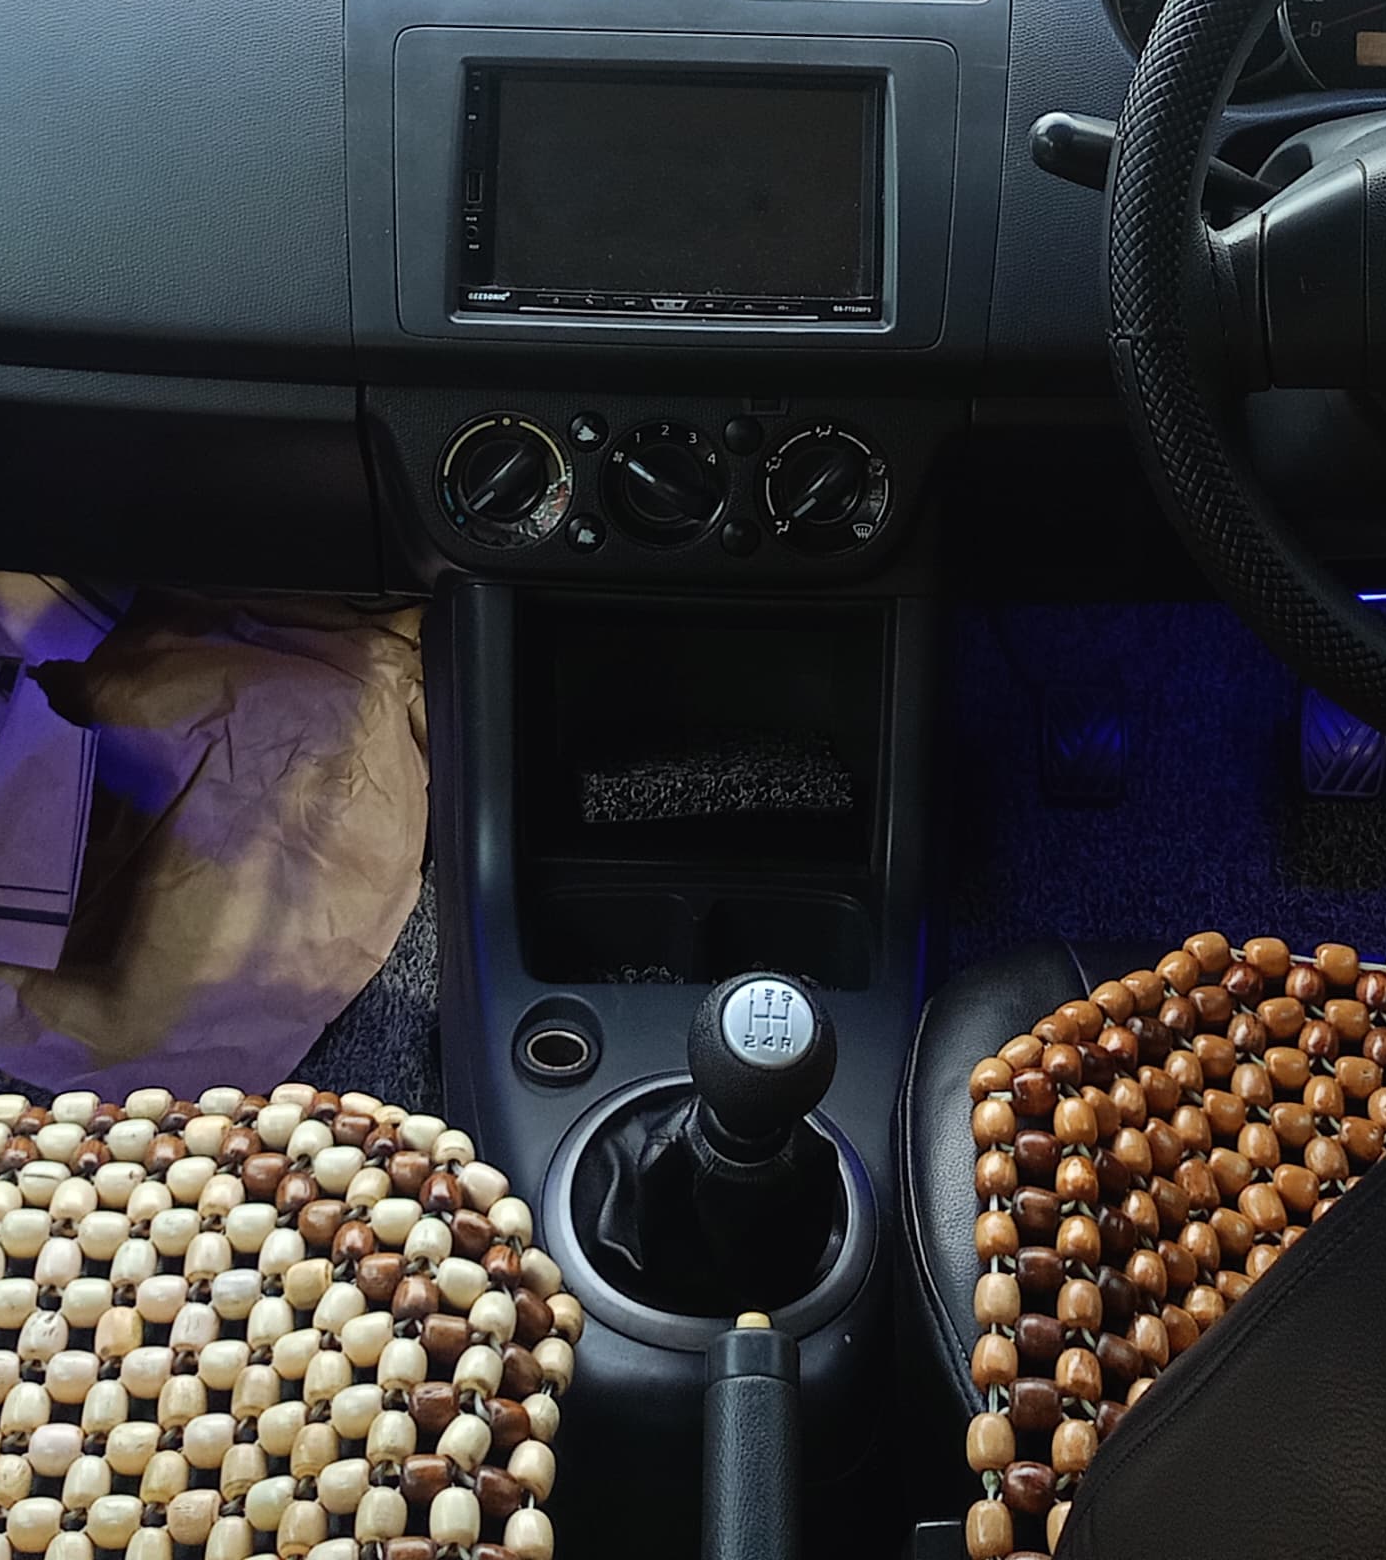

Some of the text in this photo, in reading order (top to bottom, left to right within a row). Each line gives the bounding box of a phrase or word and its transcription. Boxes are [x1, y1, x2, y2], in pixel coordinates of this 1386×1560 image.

[1310, 20, 1323, 37] 0
[660, 424, 670, 436] 2
[634, 431, 642, 444] 1
[688, 431, 699, 444] 3
[706, 451, 716, 465] 4
[781, 990, 794, 1003] 5
[744, 1034, 793, 1052] 2 4 R
